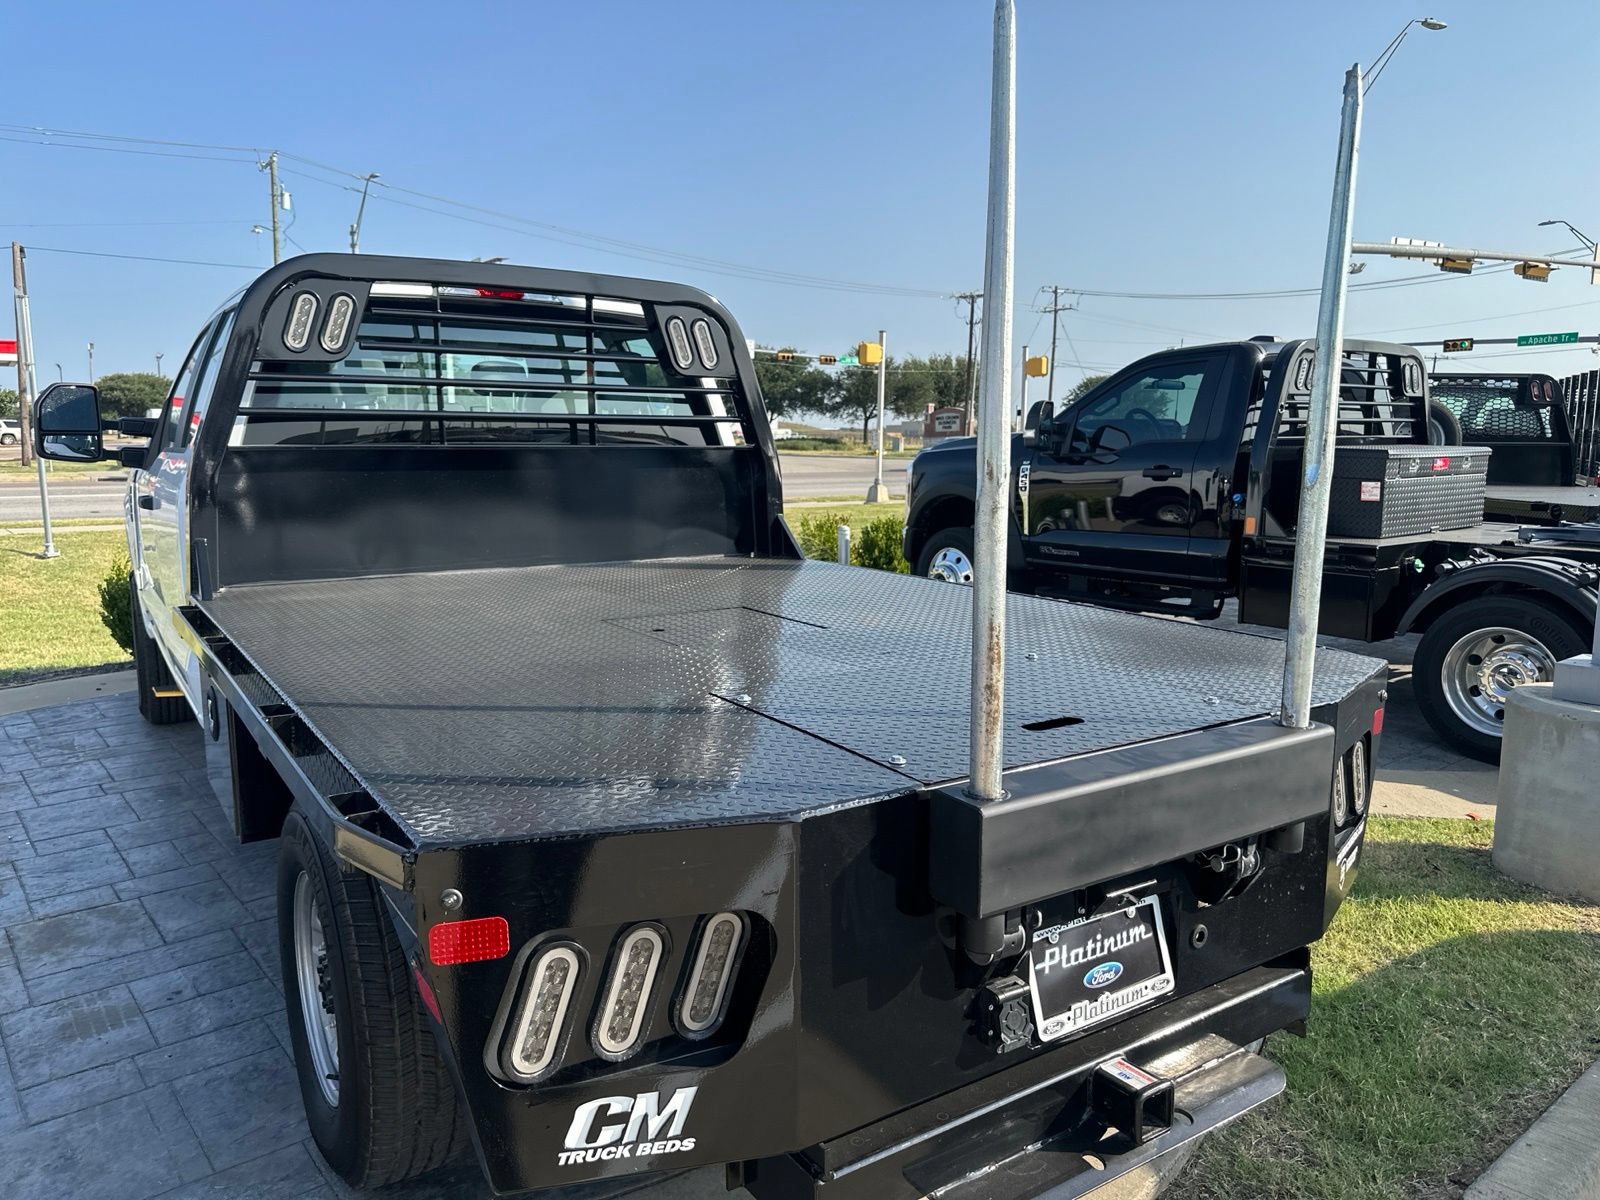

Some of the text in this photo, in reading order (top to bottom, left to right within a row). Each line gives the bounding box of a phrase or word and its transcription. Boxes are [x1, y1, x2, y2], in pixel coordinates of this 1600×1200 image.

[1528, 335, 1558, 345] Apache
[1561, 334, 1569, 342] Tr
[1034, 923, 1153, 975] Platinum
[1072, 986, 1148, 1026] Platinum
[565, 1086, 699, 1150] CM
[558, 1137, 697, 1166] TRUCK BEDS
